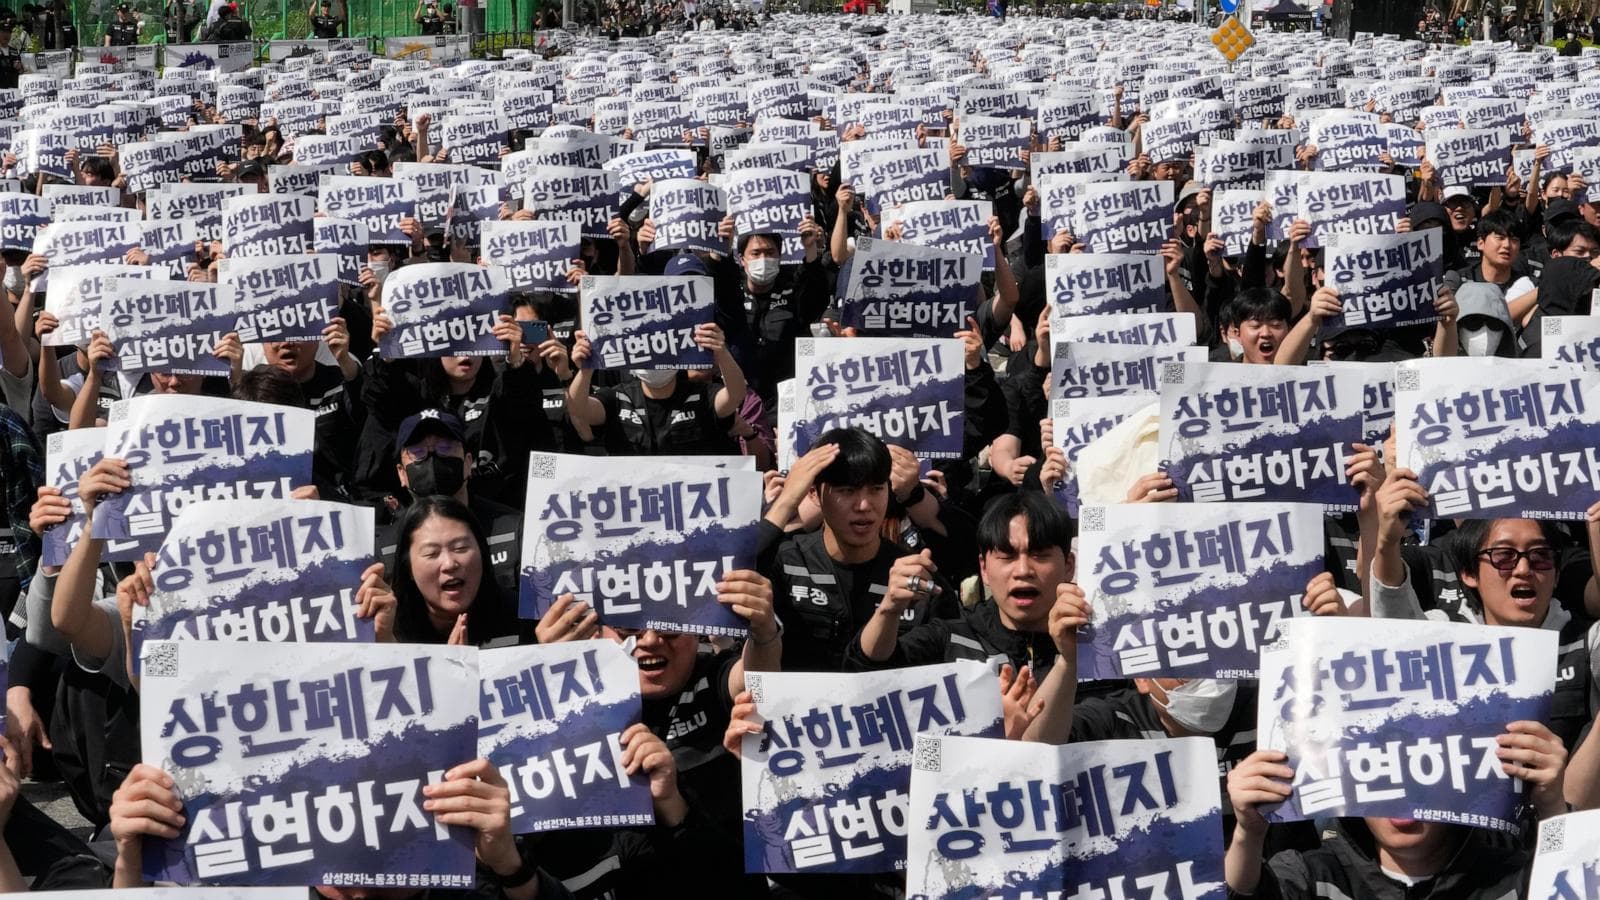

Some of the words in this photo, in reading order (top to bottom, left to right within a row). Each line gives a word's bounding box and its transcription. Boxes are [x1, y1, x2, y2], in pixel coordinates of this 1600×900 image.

[1122, 64, 1158, 77] 상한폐지
[1254, 62, 1284, 76] 상한폐지
[1388, 69, 1419, 80] 상한폐지
[23, 80, 57, 93] 상한폐지
[157, 83, 195, 97] 상한폐지
[220, 92, 257, 104] 상한폐지
[278, 82, 310, 94] 상한폐지
[388, 80, 424, 93] 상한폐지
[570, 87, 604, 99] 상한폐지
[634, 86, 675, 102] 상한폐지
[696, 93, 738, 108] 상한폐지
[751, 81, 800, 104] 상한폐지
[1172, 80, 1215, 98] 상한폐지
[1239, 85, 1282, 101] 상한폐지
[1391, 90, 1429, 105] 상한폐지
[1448, 89, 1487, 100] 상한폐지
[278, 104, 316, 119] 상한폐지
[357, 95, 394, 109] 상한폐지
[503, 93, 546, 111] 상한폐지
[965, 94, 1018, 115] 상한폐지
[1043, 102, 1091, 124] 상한폐지
[1295, 92, 1340, 110] 상한폐지
[1466, 102, 1517, 123] 상한폐지
[329, 116, 372, 135] 상한폐지
[632, 107, 680, 125] 상한폐지
[864, 108, 914, 127] 상한폐지
[445, 120, 499, 141] 상한폐지
[758, 125, 810, 142] 상한폐지
[963, 122, 1020, 141] 상한폐지
[1146, 122, 1193, 144] 상한폐지
[1318, 122, 1378, 143] 상한폐지
[1543, 122, 1597, 145] 상한폐지
[123, 144, 177, 170] 상한폐지
[295, 139, 352, 161] 상한폐지
[1211, 145, 1283, 173] 상한폐지
[1434, 132, 1500, 160] 상한폐지
[416, 169, 469, 192] 한폐지
[870, 152, 939, 185] 상한폐지
[1440, 158, 1510, 186] 실현하자
[325, 182, 403, 211] 상한폐지
[531, 173, 609, 201] 상한폐지
[727, 174, 800, 203] 상한폐지
[1305, 178, 1393, 212] 상한폐지
[652, 188, 720, 219] 상한폐지
[1082, 183, 1160, 222] 상한폐지
[226, 197, 302, 237] 상한폐지
[735, 203, 812, 234] 실현하자
[901, 204, 980, 239] 상한폐지
[50, 223, 126, 258] 상한폐지
[487, 225, 567, 257] 상한폐지
[1089, 217, 1173, 253] 실현하자
[860, 257, 966, 287] 상한폐지
[1332, 234, 1430, 282] 상한폐지
[390, 269, 491, 314] 상한폐지
[1053, 260, 1152, 303] 상한폐지
[109, 288, 217, 327] 상한폐지
[589, 281, 697, 325] 상한폐지
[863, 301, 976, 329] 실현하자
[1342, 278, 1442, 326] 실현하자
[234, 298, 338, 343] 실현하자
[118, 331, 222, 370] 실현하자
[601, 325, 704, 369] 실현하자
[806, 344, 942, 401] 상한폐지
[1175, 375, 1337, 438] 상한폐지
[1410, 378, 1584, 446] 상한폐지
[820, 401, 960, 441] 현하자
[116, 412, 286, 469] 상한폐지
[1186, 442, 1348, 500] 실현하자
[1430, 447, 1600, 518] 실현하자
[539, 477, 730, 542] 상한폐지
[157, 511, 344, 592] 상한폐지
[491, 551, 507, 565] LU
[1093, 512, 1294, 596] 상한폐지
[791, 585, 829, 606] 투쟁
[1438, 588, 1461, 604] 투
[1216, 669, 1260, 680] 삼성전자노
[1273, 637, 1516, 720] 상한폐지
[161, 656, 435, 767] 상한폐지
[759, 673, 966, 776] 상한폐지
[500, 731, 631, 818] 하자
[926, 751, 1179, 860] 상한폐지
[1413, 808, 1489, 826] 삼성전자노동조합
[186, 770, 451, 878] 실현하자
[322, 872, 407, 886] 삼성전자노동조합
[409, 873, 472, 887] 공동투쟁본부
